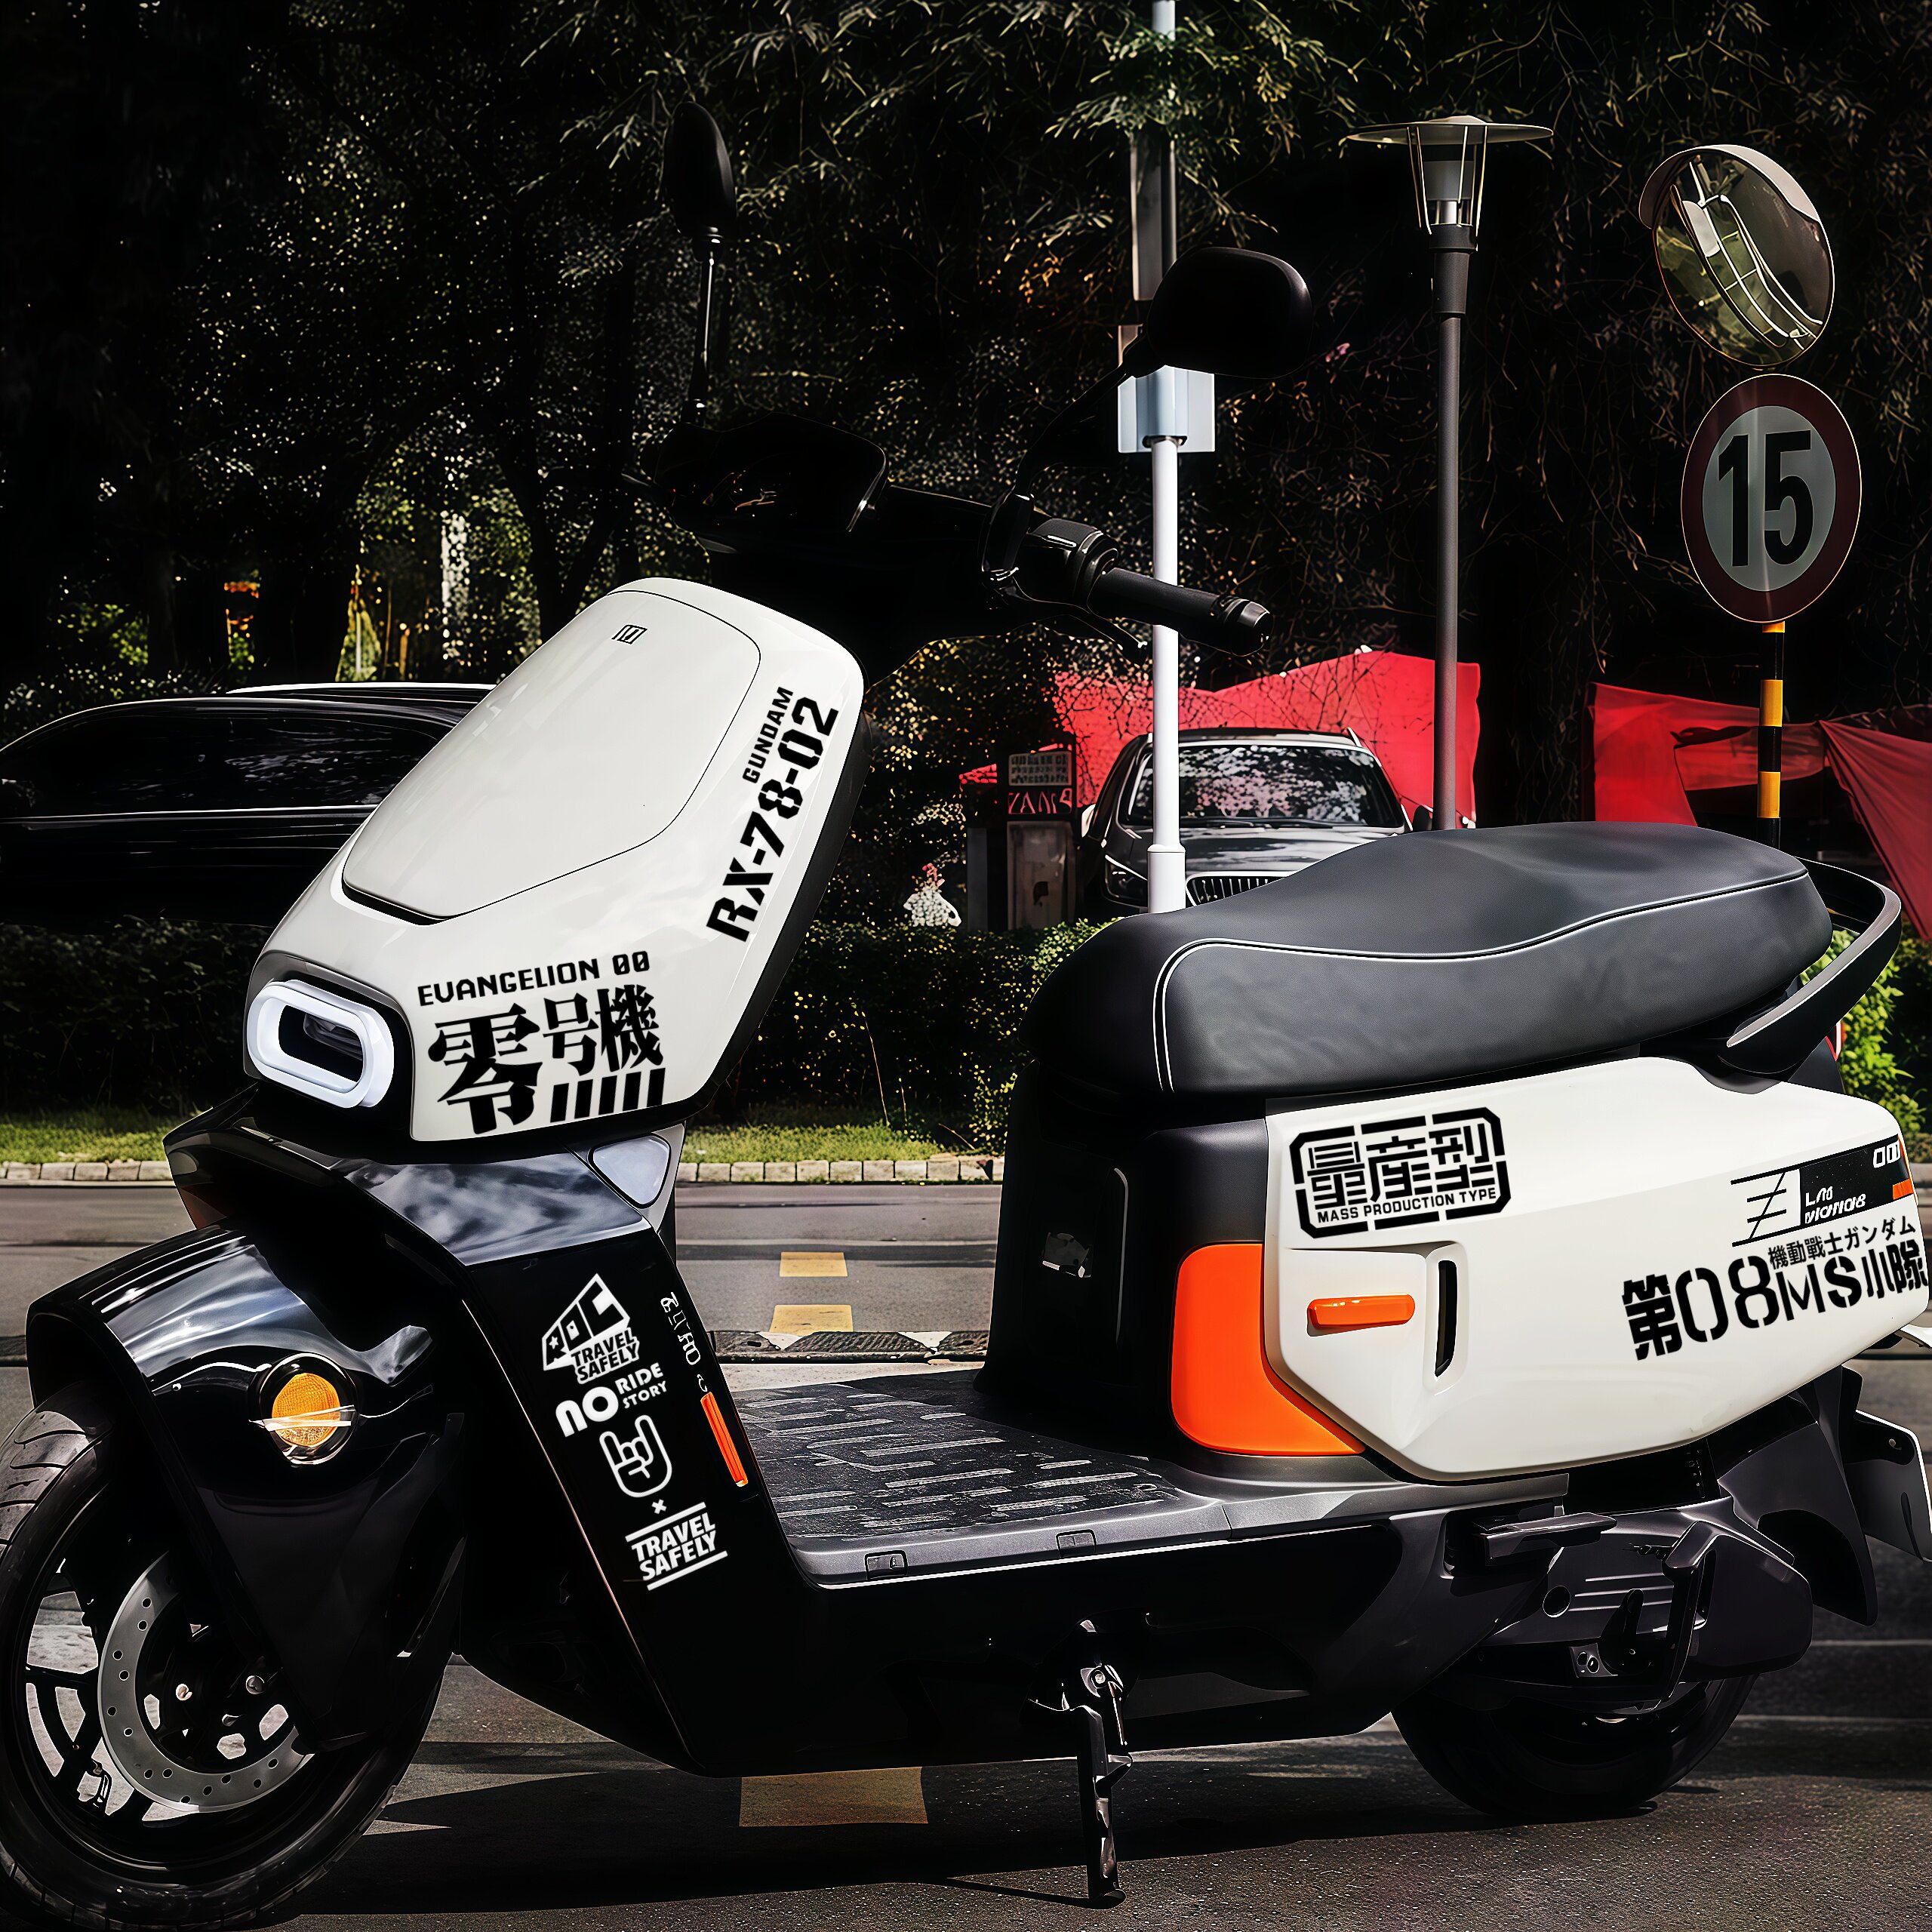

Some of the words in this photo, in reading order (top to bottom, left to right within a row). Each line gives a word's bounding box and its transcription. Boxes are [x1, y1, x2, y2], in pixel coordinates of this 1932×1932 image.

[1718, 429, 1814, 567] 15
[743, 686, 793, 783] GUNDAM
[706, 697, 839, 943] RX-78-02
[417, 958, 599, 1007] EVANGELION
[612, 950, 650, 976] 00
[428, 984, 664, 1134] 零号機
[1317, 1206, 1359, 1223] MASS
[1364, 1192, 1455, 1217] PRODUCTION
[1459, 1186, 1497, 1204] TYPE
[571, 1329, 635, 1367] TRAVEL
[577, 1343, 637, 1381] SAFELY
[614, 1362, 663, 1395] RIDE
[623, 1380, 667, 1409] STORY
[631, 1512, 715, 1562] TRAVEL
[639, 1530, 716, 1581] SAFELY
